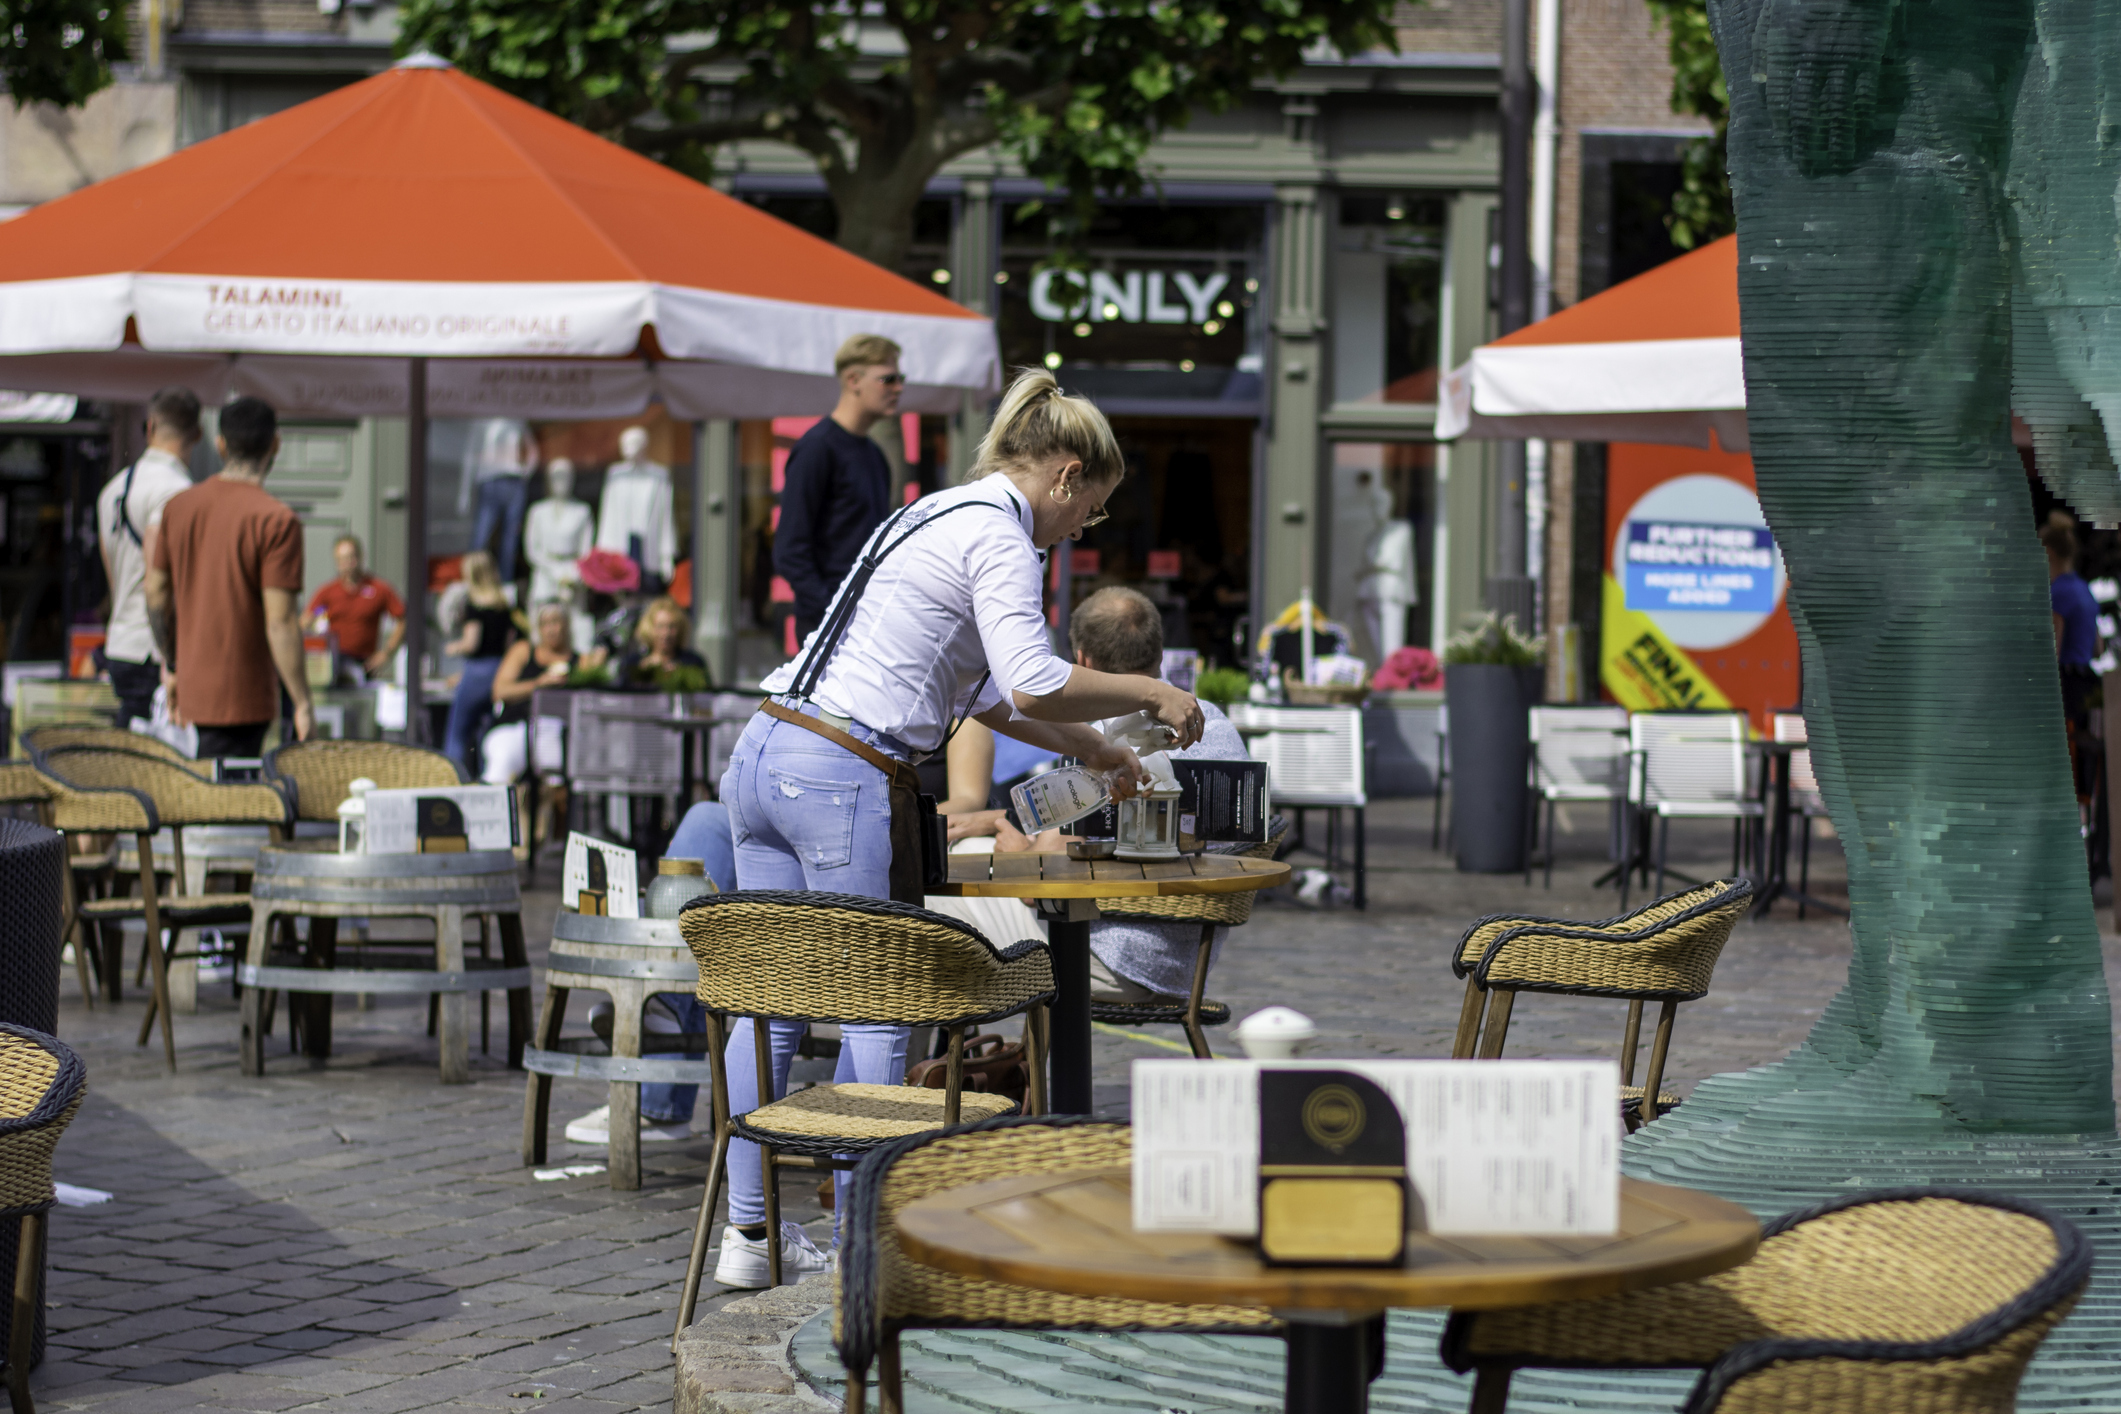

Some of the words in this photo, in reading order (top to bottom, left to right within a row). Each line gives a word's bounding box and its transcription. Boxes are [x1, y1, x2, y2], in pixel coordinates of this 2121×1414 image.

[1029, 269, 1230, 323] ONLY
[204, 308, 305, 335] GELATO
[312, 312, 430, 339] ITALIANO
[436, 314, 571, 340] ORIGINALE
[1648, 524, 1756, 548] FURTHER
[1628, 542, 1772, 569] REDUCTIONS
[1644, 572, 1698, 588] MORE
[1700, 573, 1754, 590] LINES
[1667, 589, 1732, 605] ADDED
